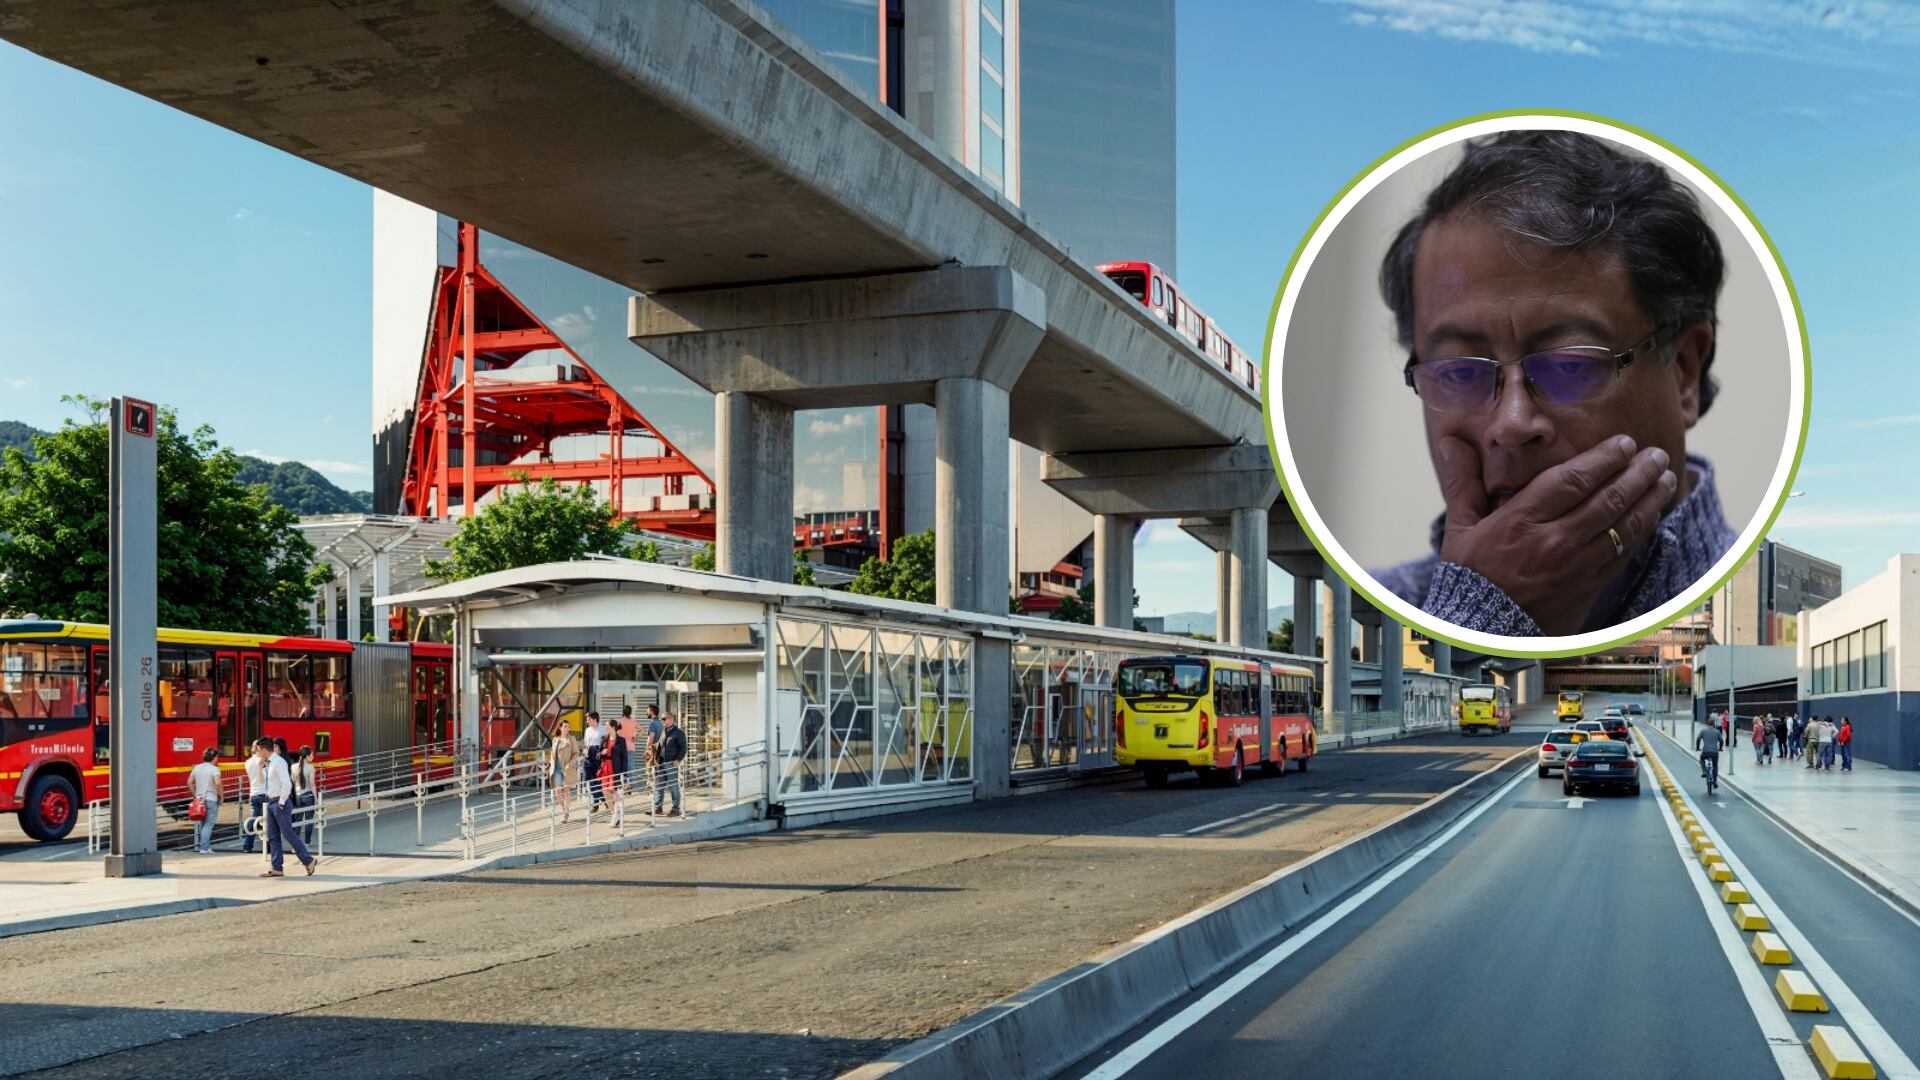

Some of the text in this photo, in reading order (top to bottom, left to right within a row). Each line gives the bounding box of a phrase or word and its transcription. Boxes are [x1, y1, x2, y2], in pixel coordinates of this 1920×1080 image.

[141, 657, 152, 721] Calle 26
[31, 743, 85, 754] TransMilenio
